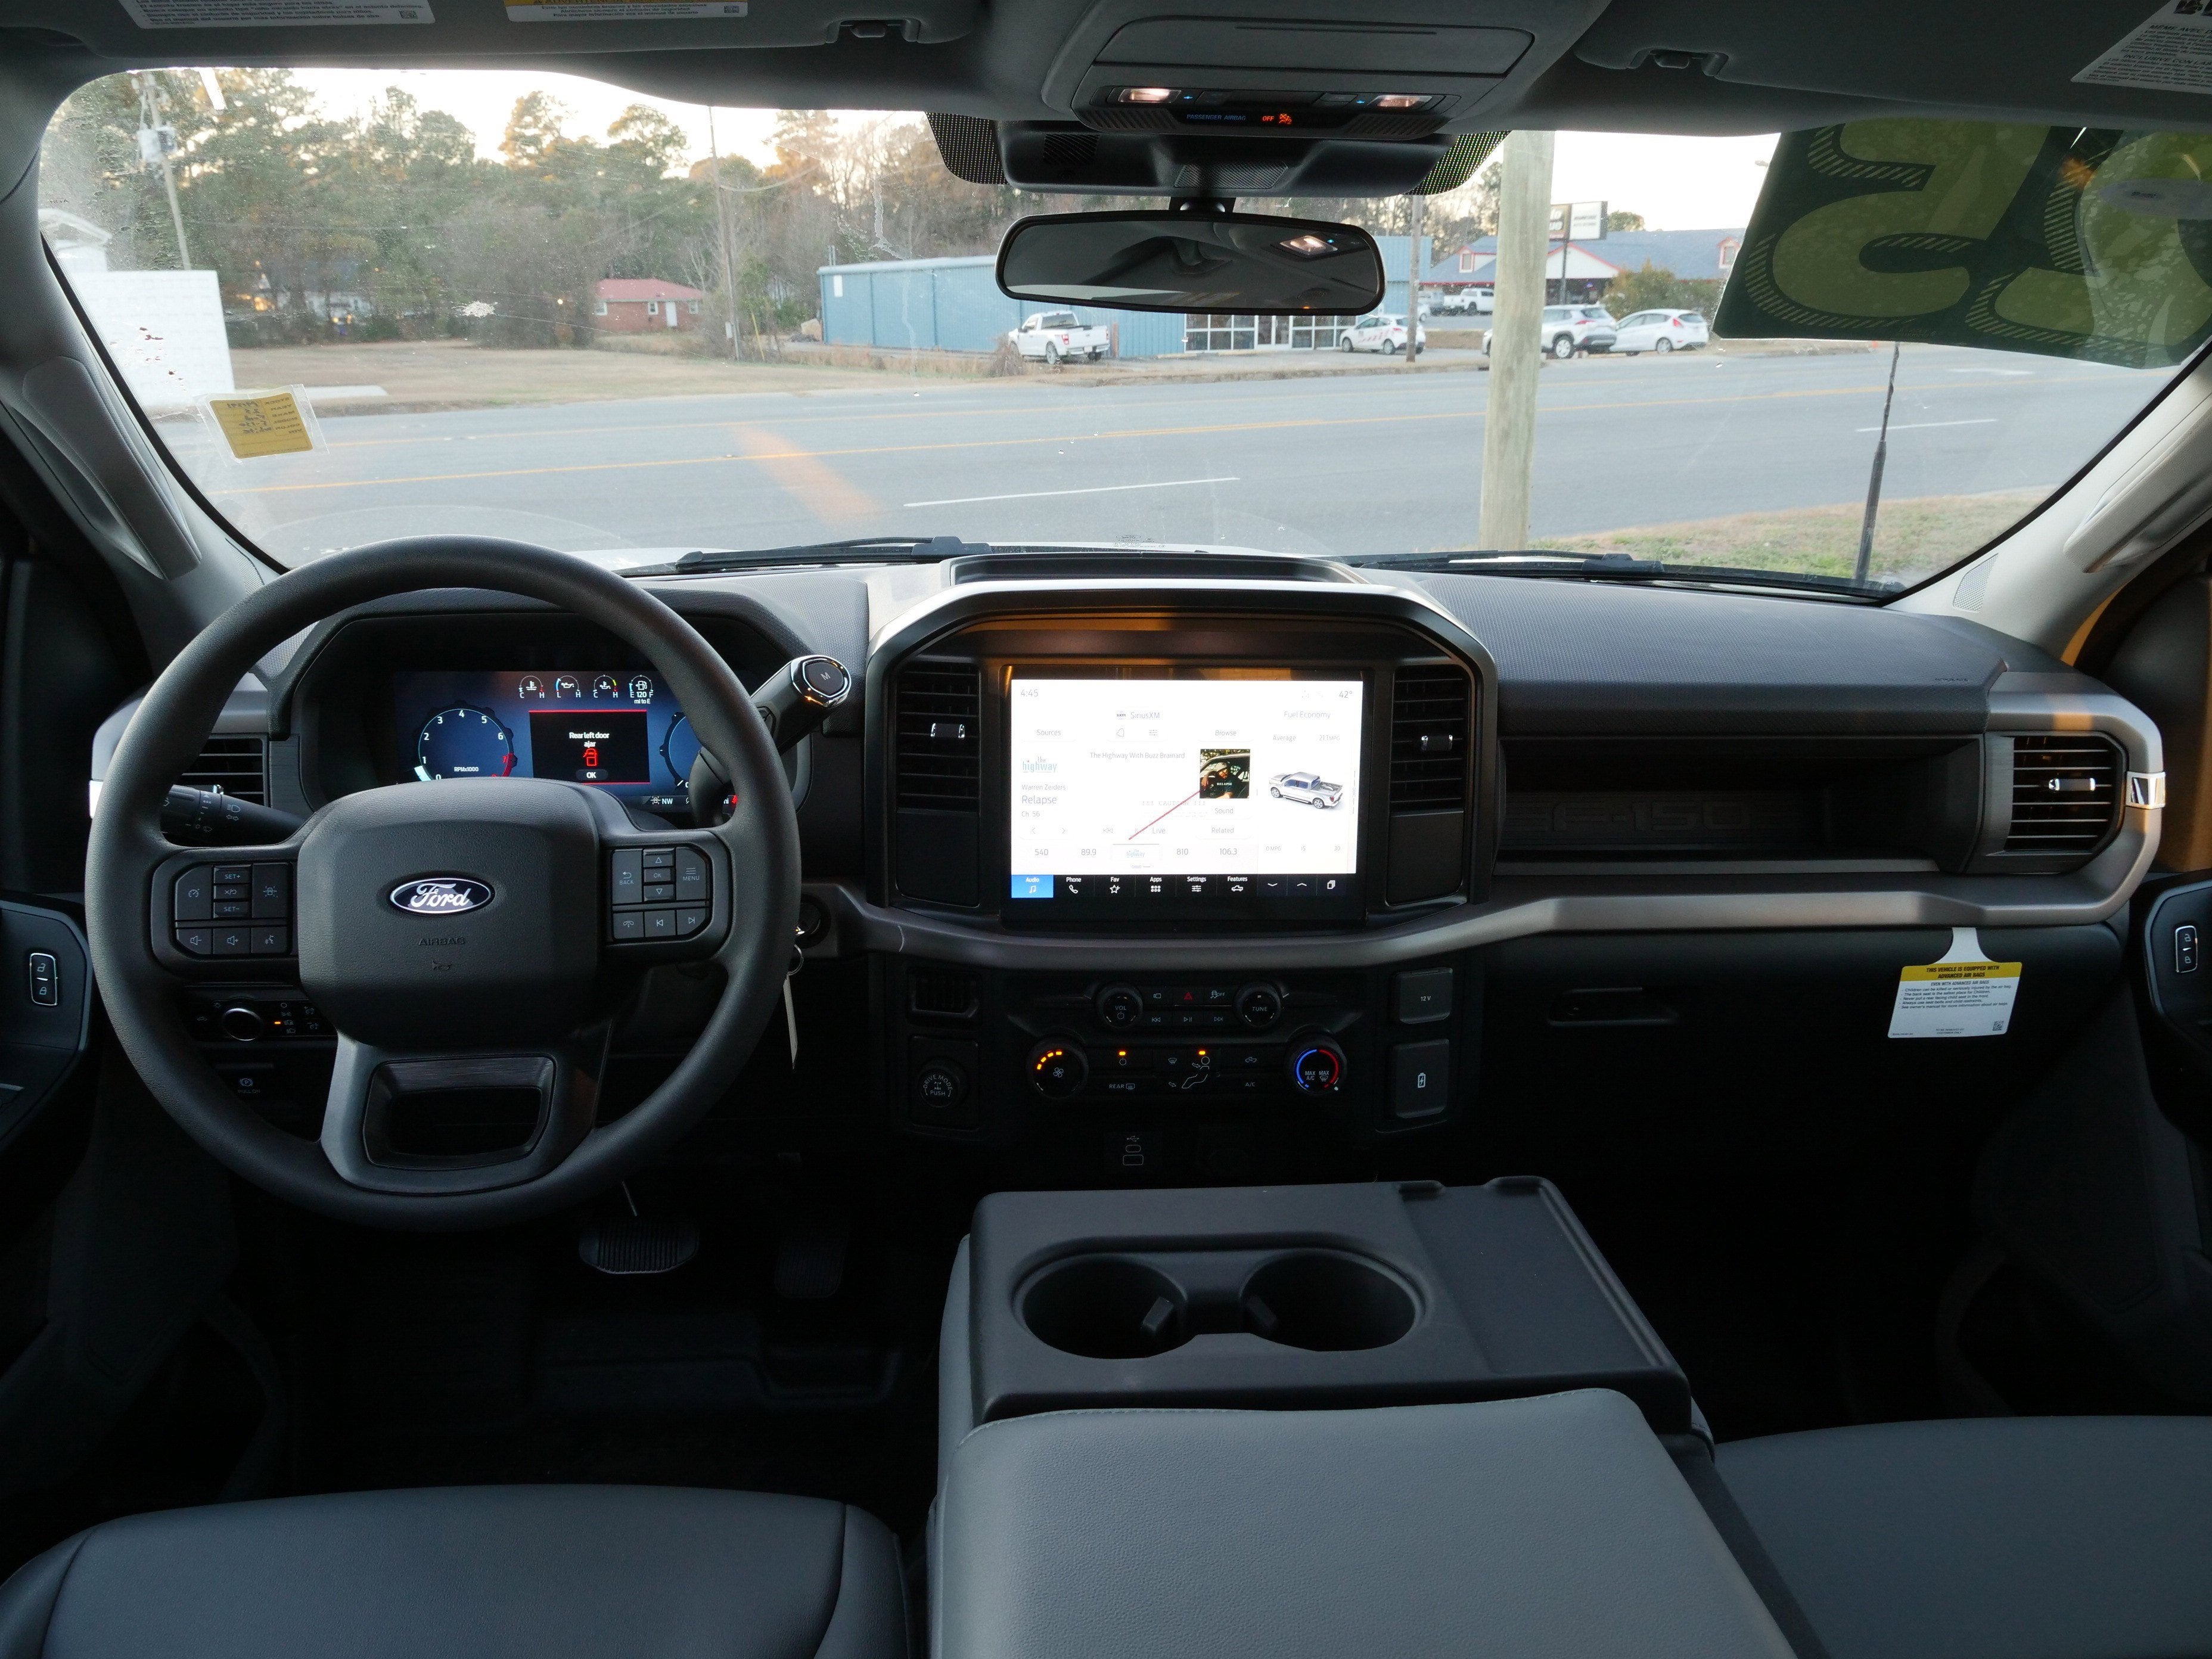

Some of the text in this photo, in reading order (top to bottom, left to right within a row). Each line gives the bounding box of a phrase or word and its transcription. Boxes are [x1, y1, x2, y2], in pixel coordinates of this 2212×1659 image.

[820, 672, 831, 681] M
[1020, 689, 1039, 697] 4:45
[1300, 711, 1331, 720] Economy
[1102, 752, 1128, 760] Highway
[1022, 762, 1057, 773] highway
[1021, 795, 1057, 806] Relapse
[410, 883, 471, 908] Ford
[419, 936, 466, 946] AIRBAG
[922, 1074, 953, 1091] DRIVE MODE
